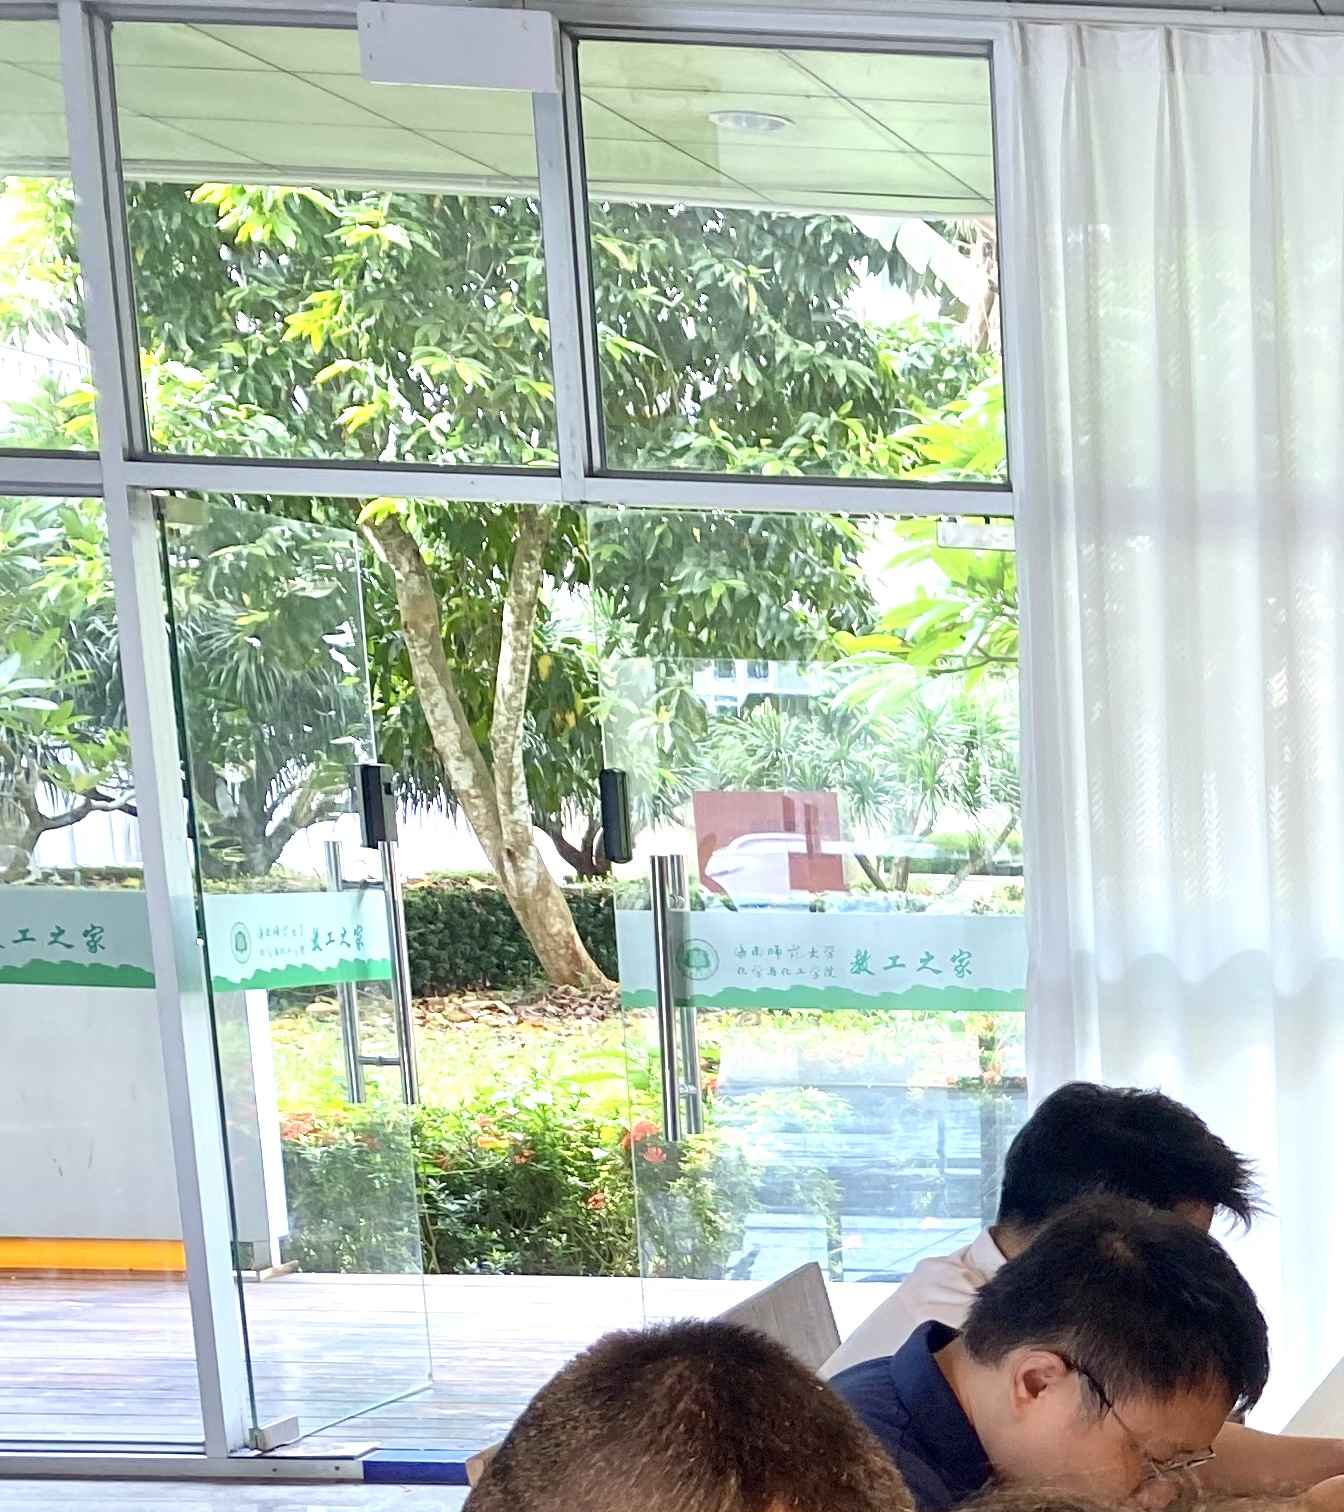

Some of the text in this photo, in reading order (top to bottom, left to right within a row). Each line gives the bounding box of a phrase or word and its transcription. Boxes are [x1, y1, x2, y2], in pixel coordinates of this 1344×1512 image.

[0, 923, 105, 954] 工之家
[849, 948, 973, 979] 教工之家
